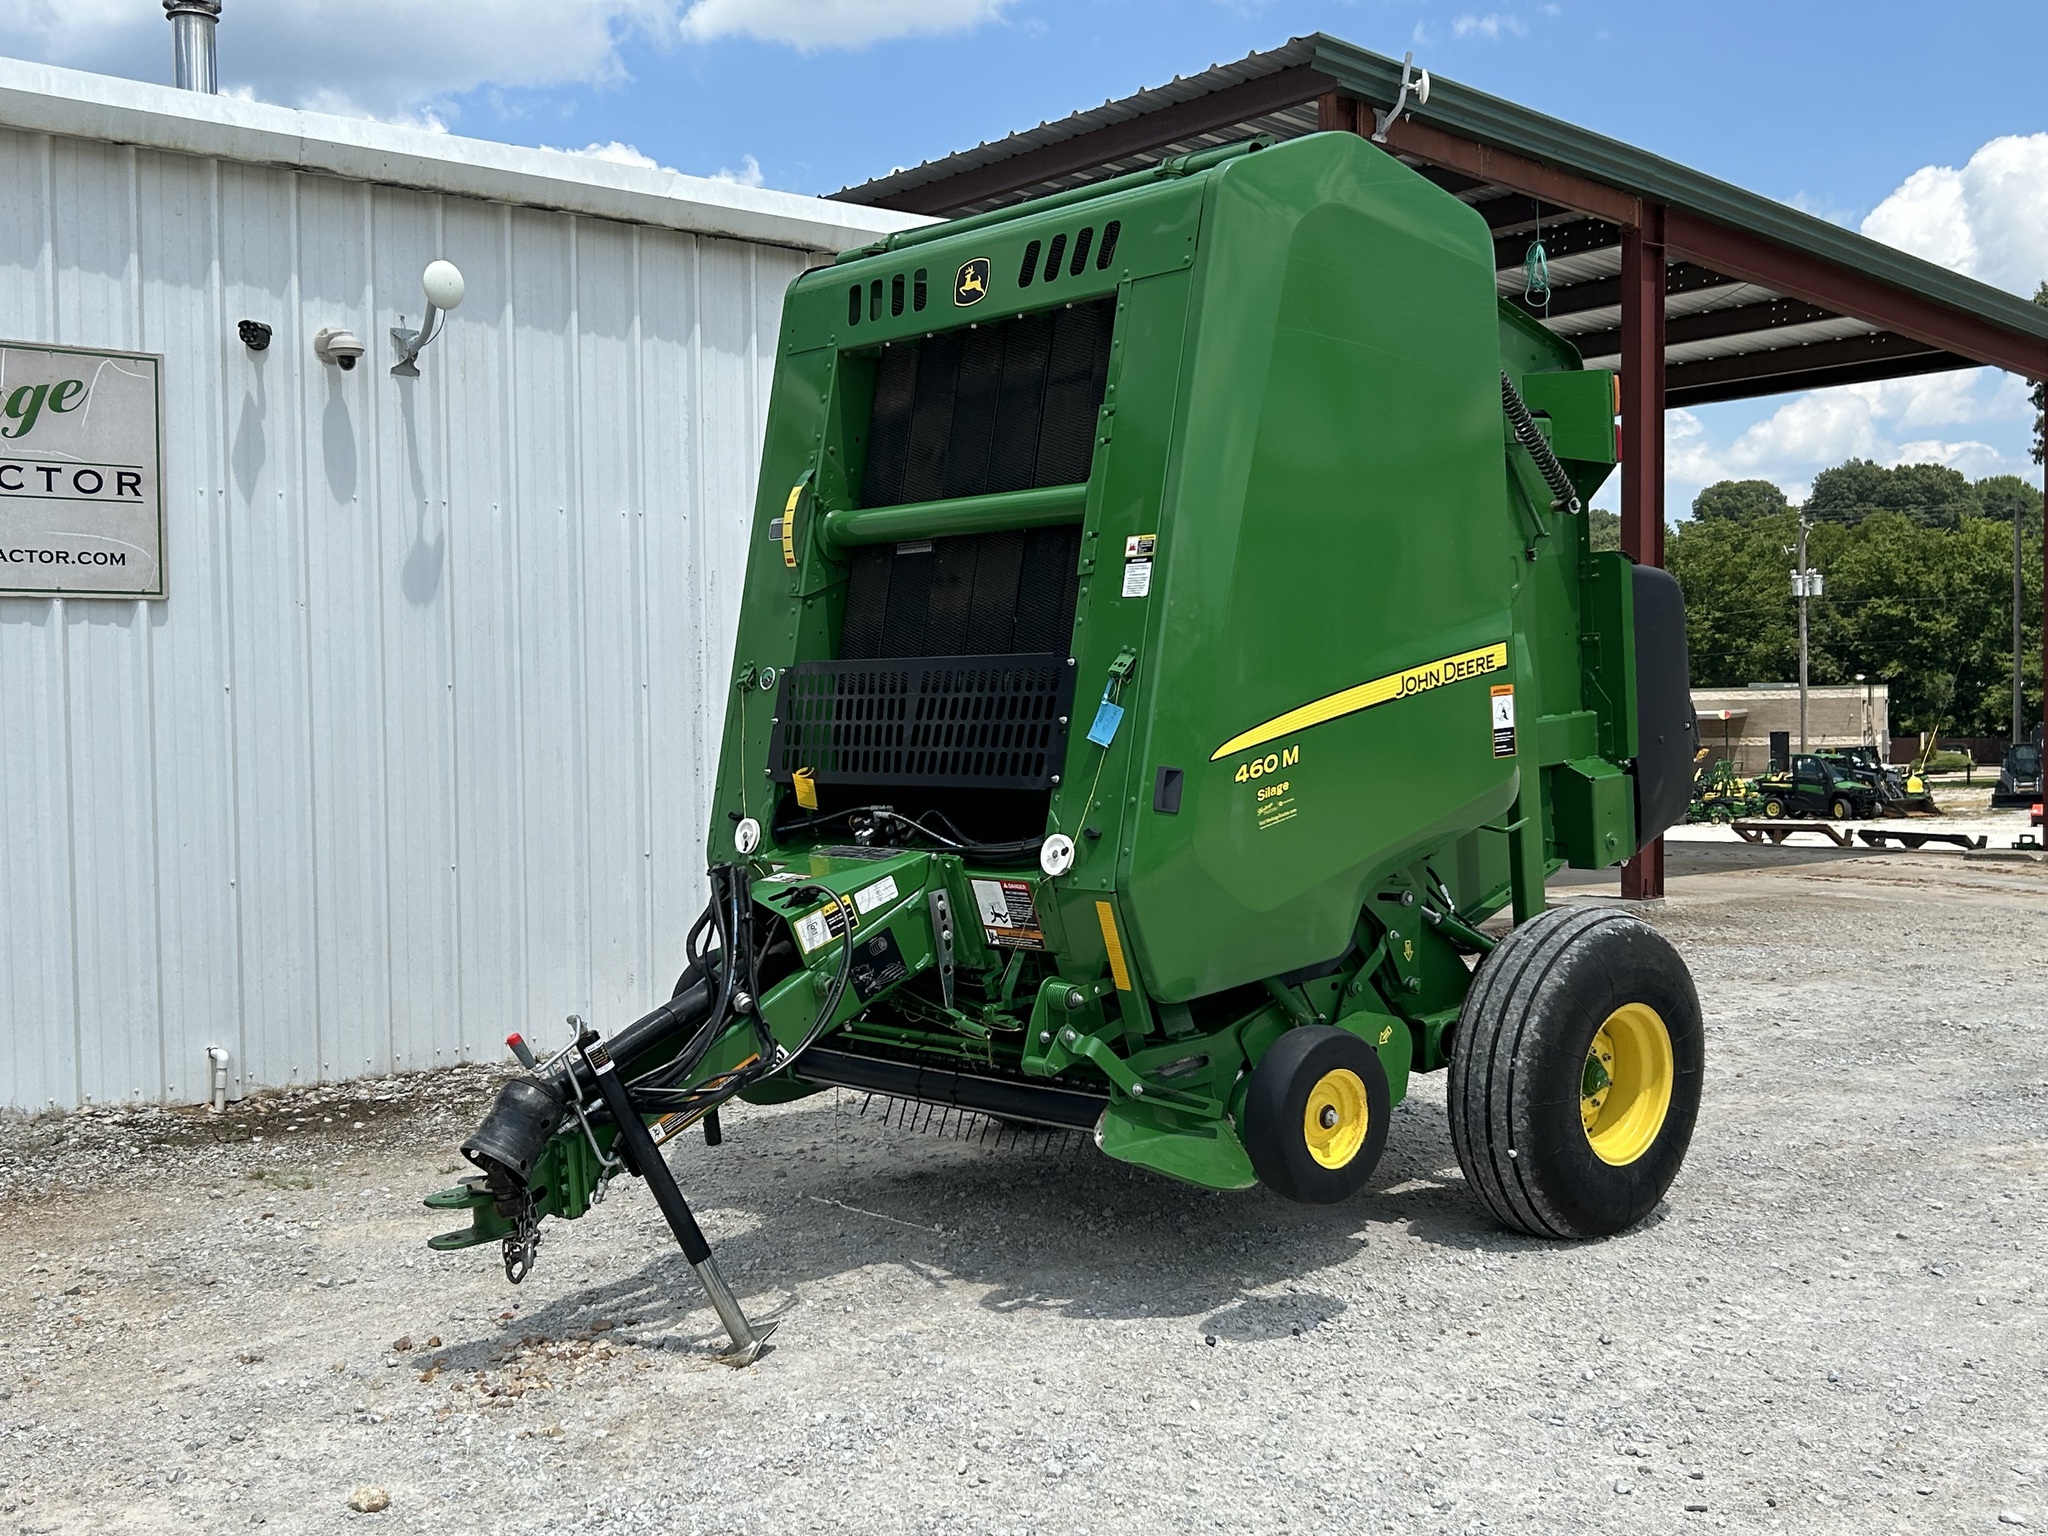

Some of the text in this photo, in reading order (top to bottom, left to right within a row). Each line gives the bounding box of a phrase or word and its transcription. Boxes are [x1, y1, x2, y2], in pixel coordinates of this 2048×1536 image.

[0, 378, 90, 439] ge
[1395, 653, 1495, 697] JOHN DEERE
[1234, 743, 1300, 784] 460 M
[1256, 780, 1290, 802] Silage
